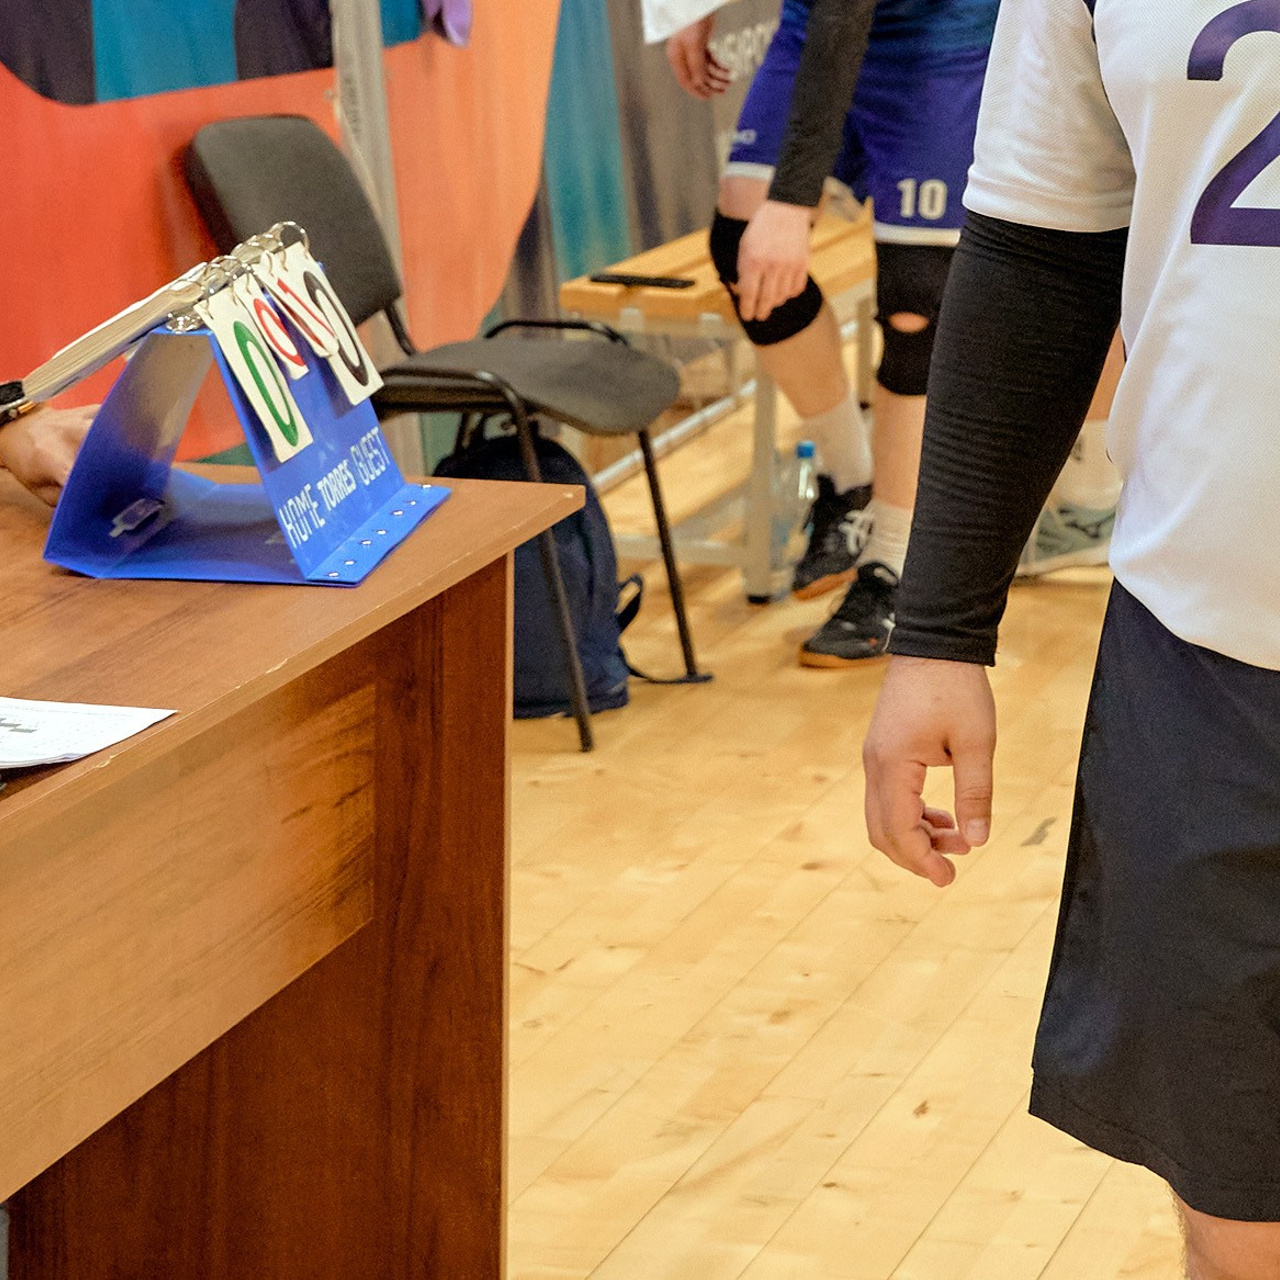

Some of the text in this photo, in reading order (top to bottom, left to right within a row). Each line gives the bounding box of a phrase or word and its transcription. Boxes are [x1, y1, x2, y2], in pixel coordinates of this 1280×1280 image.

[896, 178, 948, 221] 10
[279, 426, 391, 549] HOME TORRES GUEST
